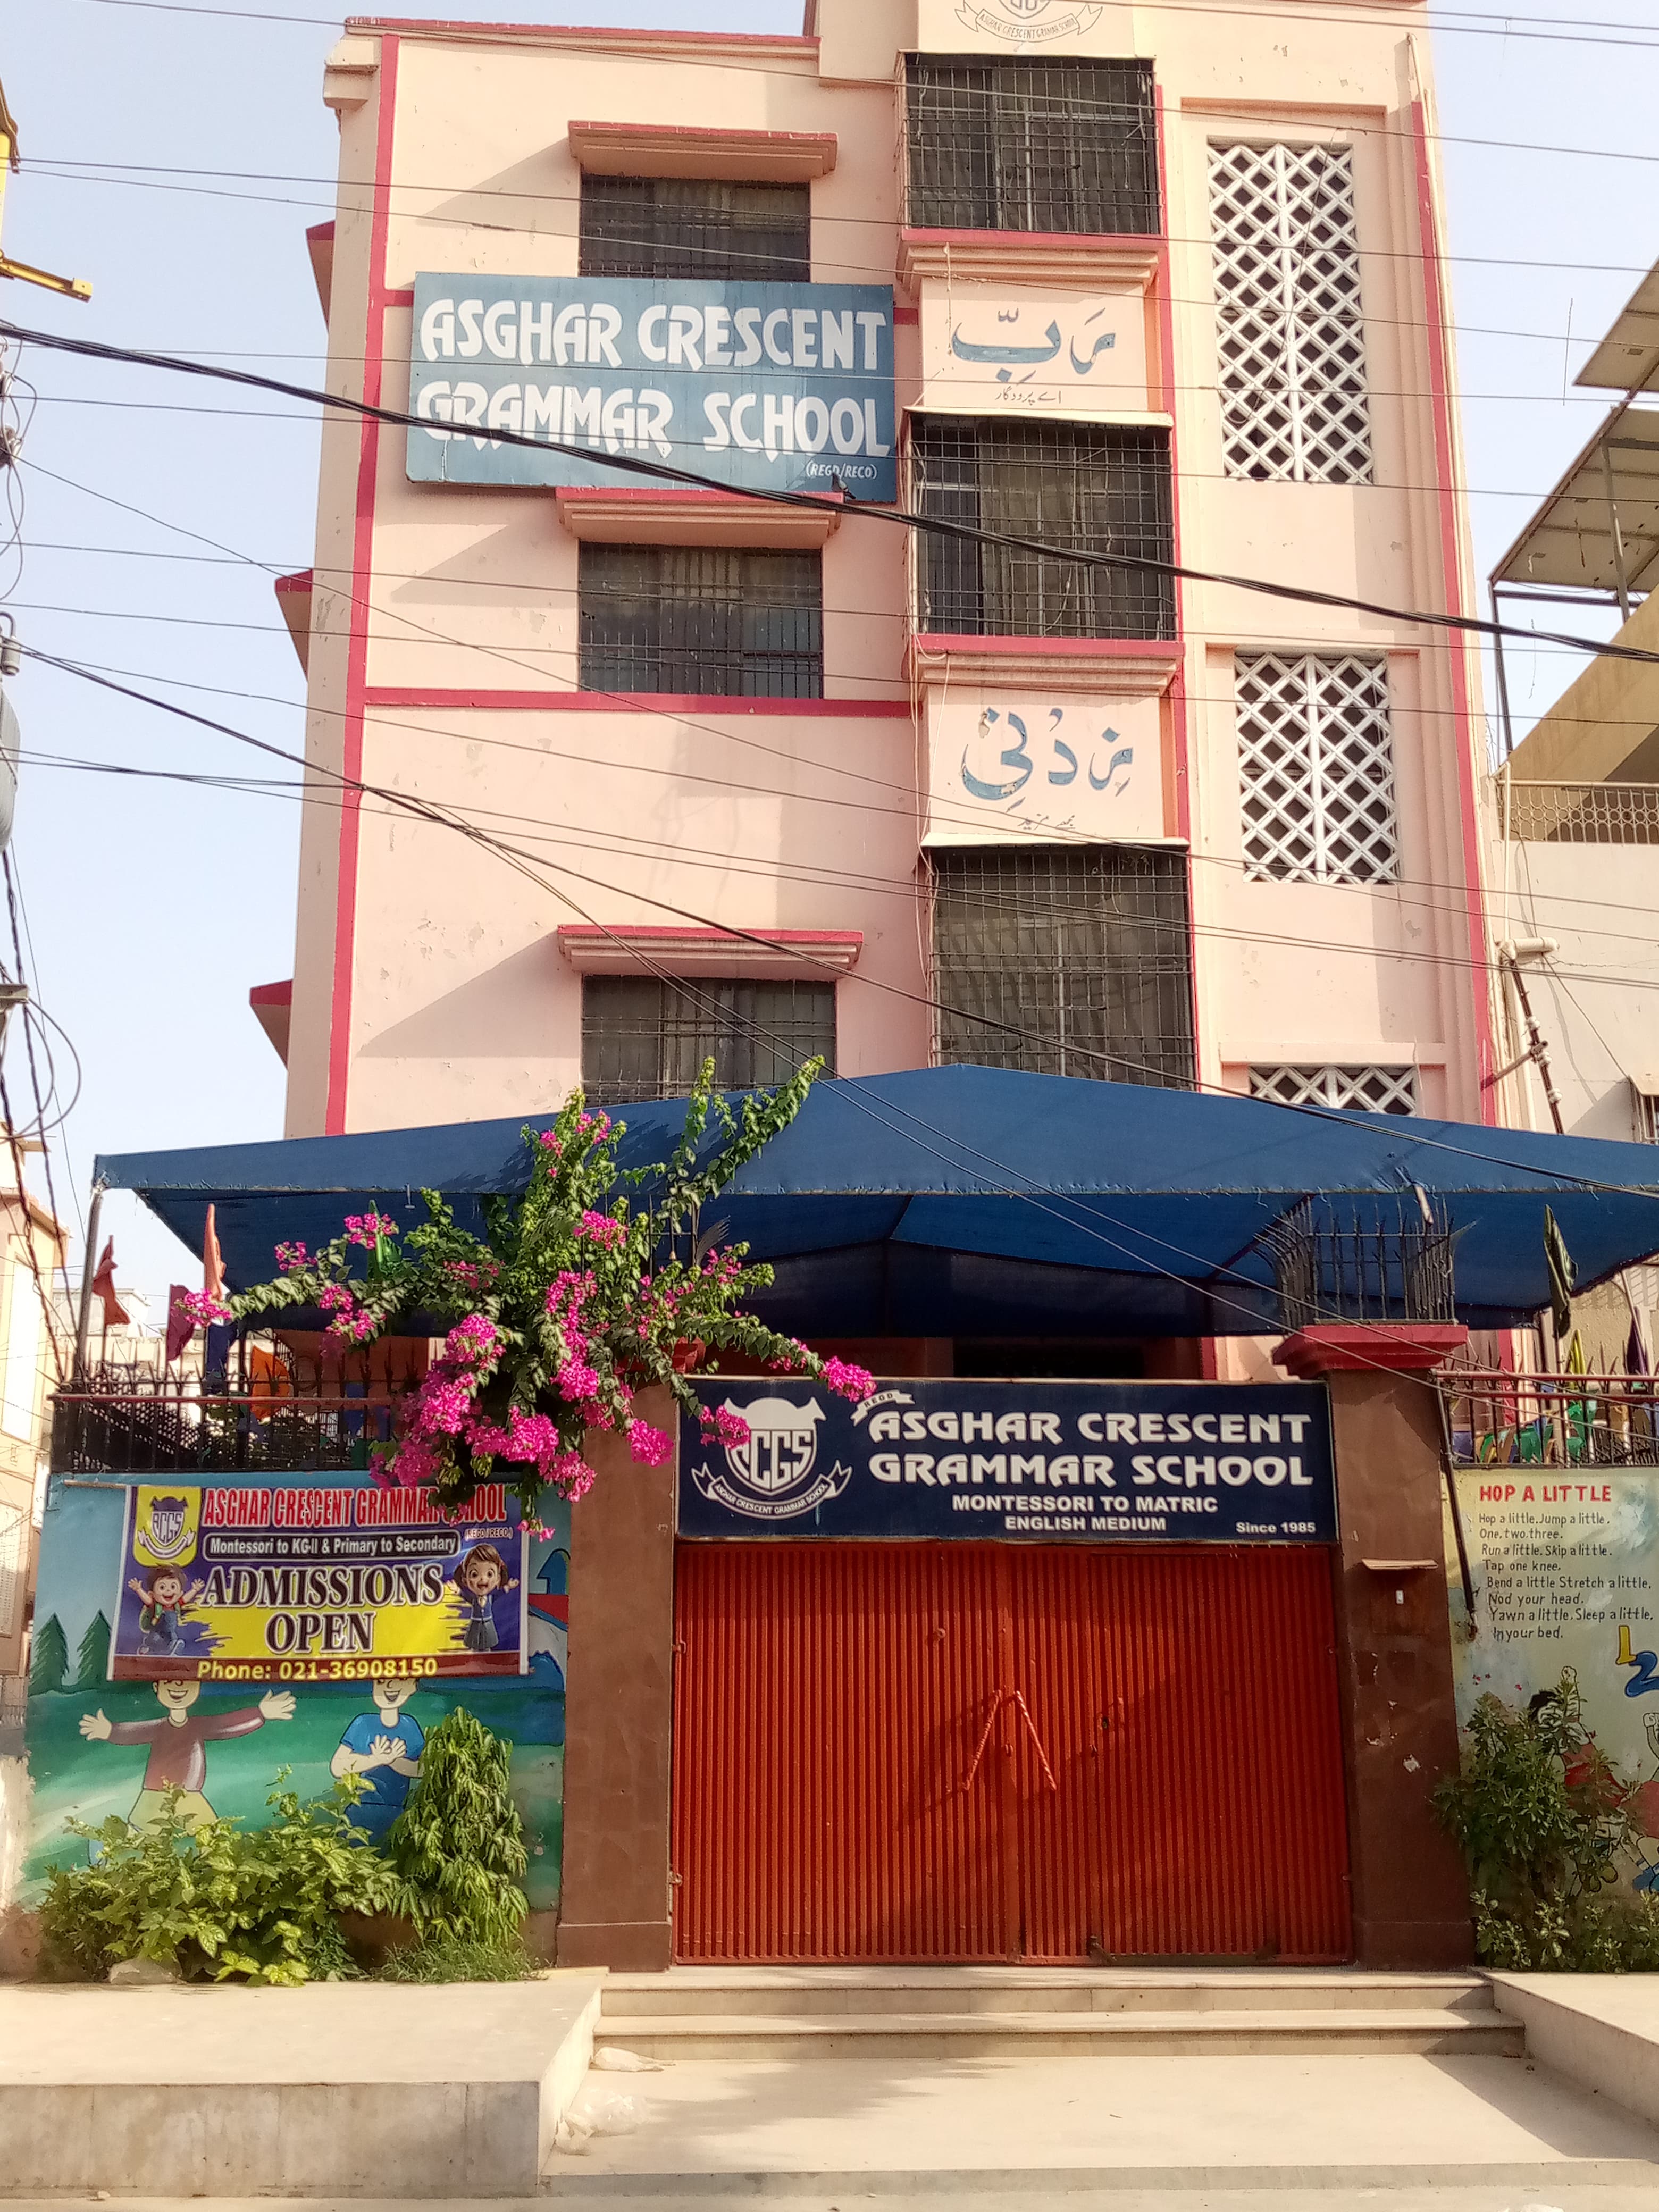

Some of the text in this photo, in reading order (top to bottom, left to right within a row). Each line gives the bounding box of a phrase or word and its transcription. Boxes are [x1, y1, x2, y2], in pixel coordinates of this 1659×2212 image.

[420, 298, 886, 371] ASGHAR CRESCENT
[417, 380, 891, 463] GRAMMAR SCHOOL
[864, 1392, 894, 1409] REGD
[869, 1410, 1312, 1445] ASGHAR CRESCENT
[869, 1453, 1313, 1488] GRAMMAR SCHOOL
[736, 1498, 773, 1514] CRESCENT
[806, 1482, 830, 1504] SCHOOL
[1480, 1485, 1612, 1502] HOP A LITTLE
[203, 1488, 272, 1527] ASGHAR
[273, 1488, 354, 1527] CRESCENT
[952, 1495, 1218, 1513] MONTESSORI TO MATRIC
[1005, 1515, 1167, 1531] ENGLISH MEDIUM
[1236, 1521, 1316, 1534] Since 1985
[1479, 1513, 1496, 1526] Hop
[1509, 1512, 1538, 1524] little.
[1539, 1513, 1567, 1528] Jump
[1570, 1515, 1576, 1524] a
[1529, 1527, 1563, 1539] three.
[211, 1537, 273, 1554] Montessori
[276, 1539, 288, 1554] to
[321, 1538, 330, 1554] &
[333, 1537, 378, 1556] Primary
[381, 1537, 392, 1552] to
[396, 1535, 456, 1554] Secondary
[1482, 1543, 1501, 1556] Run
[1545, 1544, 1567, 1559] Skip
[1570, 1547, 1576, 1556] a
[1482, 1559, 1504, 1574] Tap
[1510, 1562, 1528, 1571] one
[200, 1564, 444, 1607] ADMISSIONS
[1488, 1576, 1512, 1588] Bend
[1527, 1576, 1555, 1588] little
[1559, 1576, 1604, 1588] Stretch
[1608, 1579, 1615, 1588] a
[1489, 1591, 1584, 1608] Nod your head.
[1489, 1606, 1525, 1621] Yawn
[1529, 1612, 1535, 1621] a
[1575, 1607, 1605, 1623] Sleep
[1610, 1611, 1616, 1620] a
[265, 1612, 376, 1655] OPEN
[1493, 1624, 1563, 1643] In your bed.
[1616, 1625, 1637, 1665] 1
[197, 1658, 439, 1680] Phone: 021-36908150
[1625, 1650, 1659, 1697] 2
